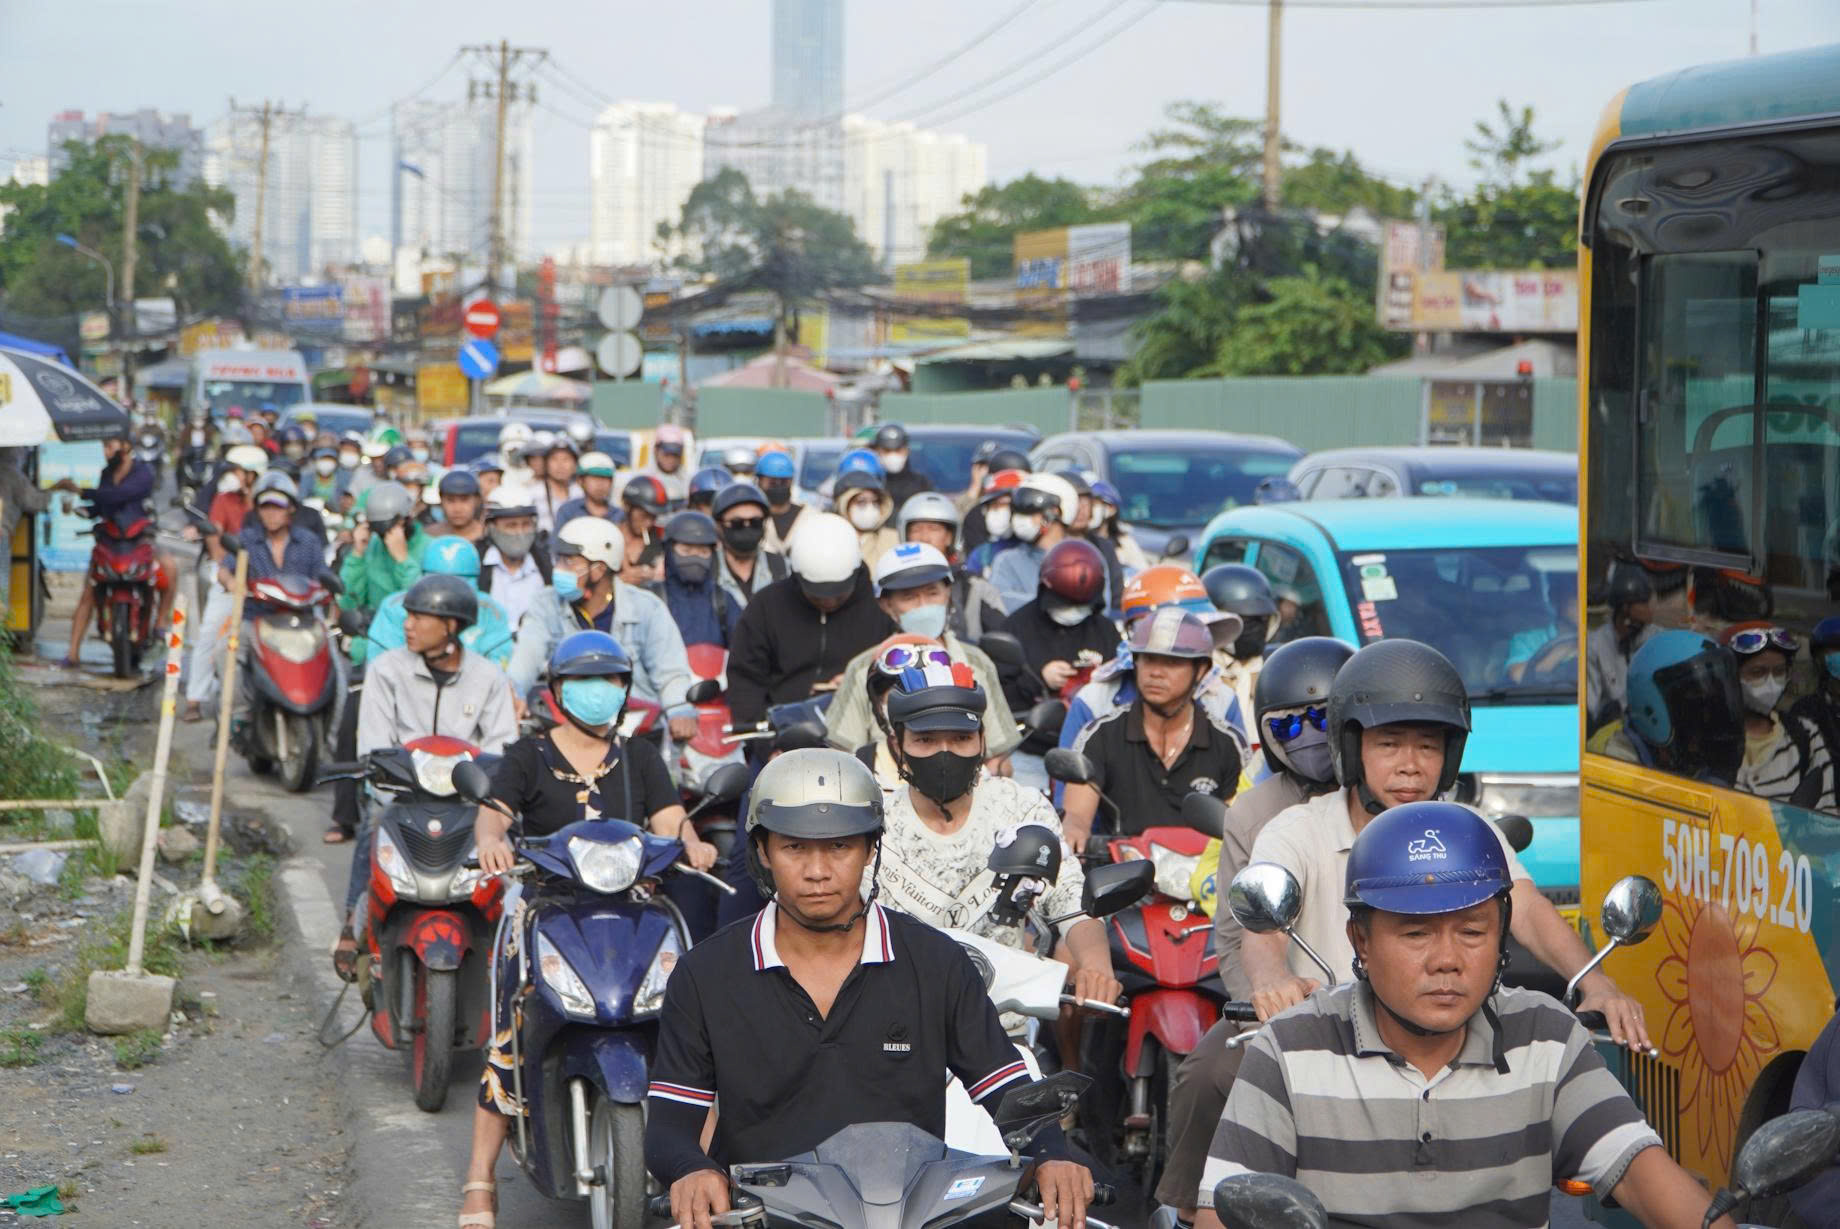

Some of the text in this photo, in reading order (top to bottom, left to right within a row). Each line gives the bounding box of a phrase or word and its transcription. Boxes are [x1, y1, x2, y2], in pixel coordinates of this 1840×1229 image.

[1409, 854, 1431, 862] SANG
[1663, 819, 1813, 935] 50H-709.20
[883, 1043, 911, 1051] BLEUES
